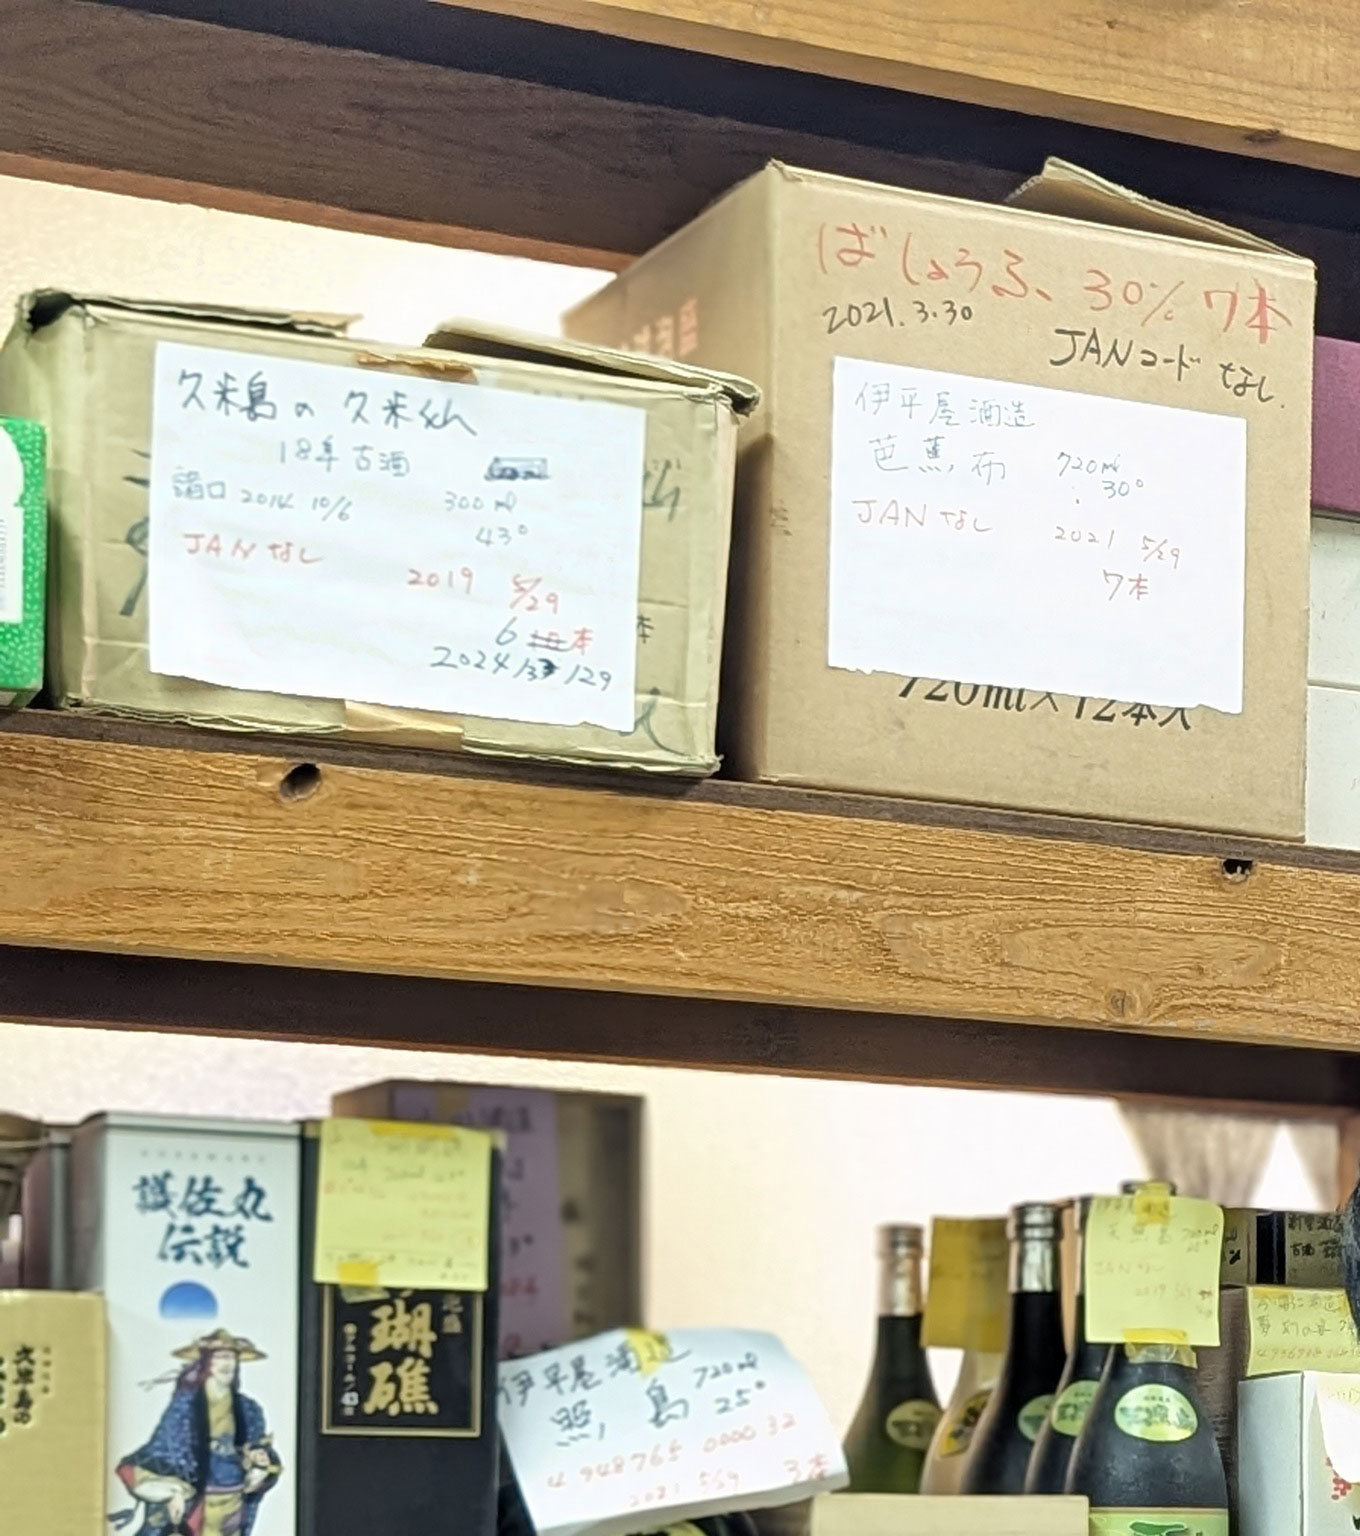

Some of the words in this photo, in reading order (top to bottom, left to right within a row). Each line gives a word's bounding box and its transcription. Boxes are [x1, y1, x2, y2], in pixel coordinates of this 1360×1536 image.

[822, 298, 974, 334] 2021.3.30
[851, 498, 928, 529] JAN
[183, 531, 257, 562] JAN
[406, 566, 474, 595] 2019
[363, 1287, 438, 1417] 瑚礁
